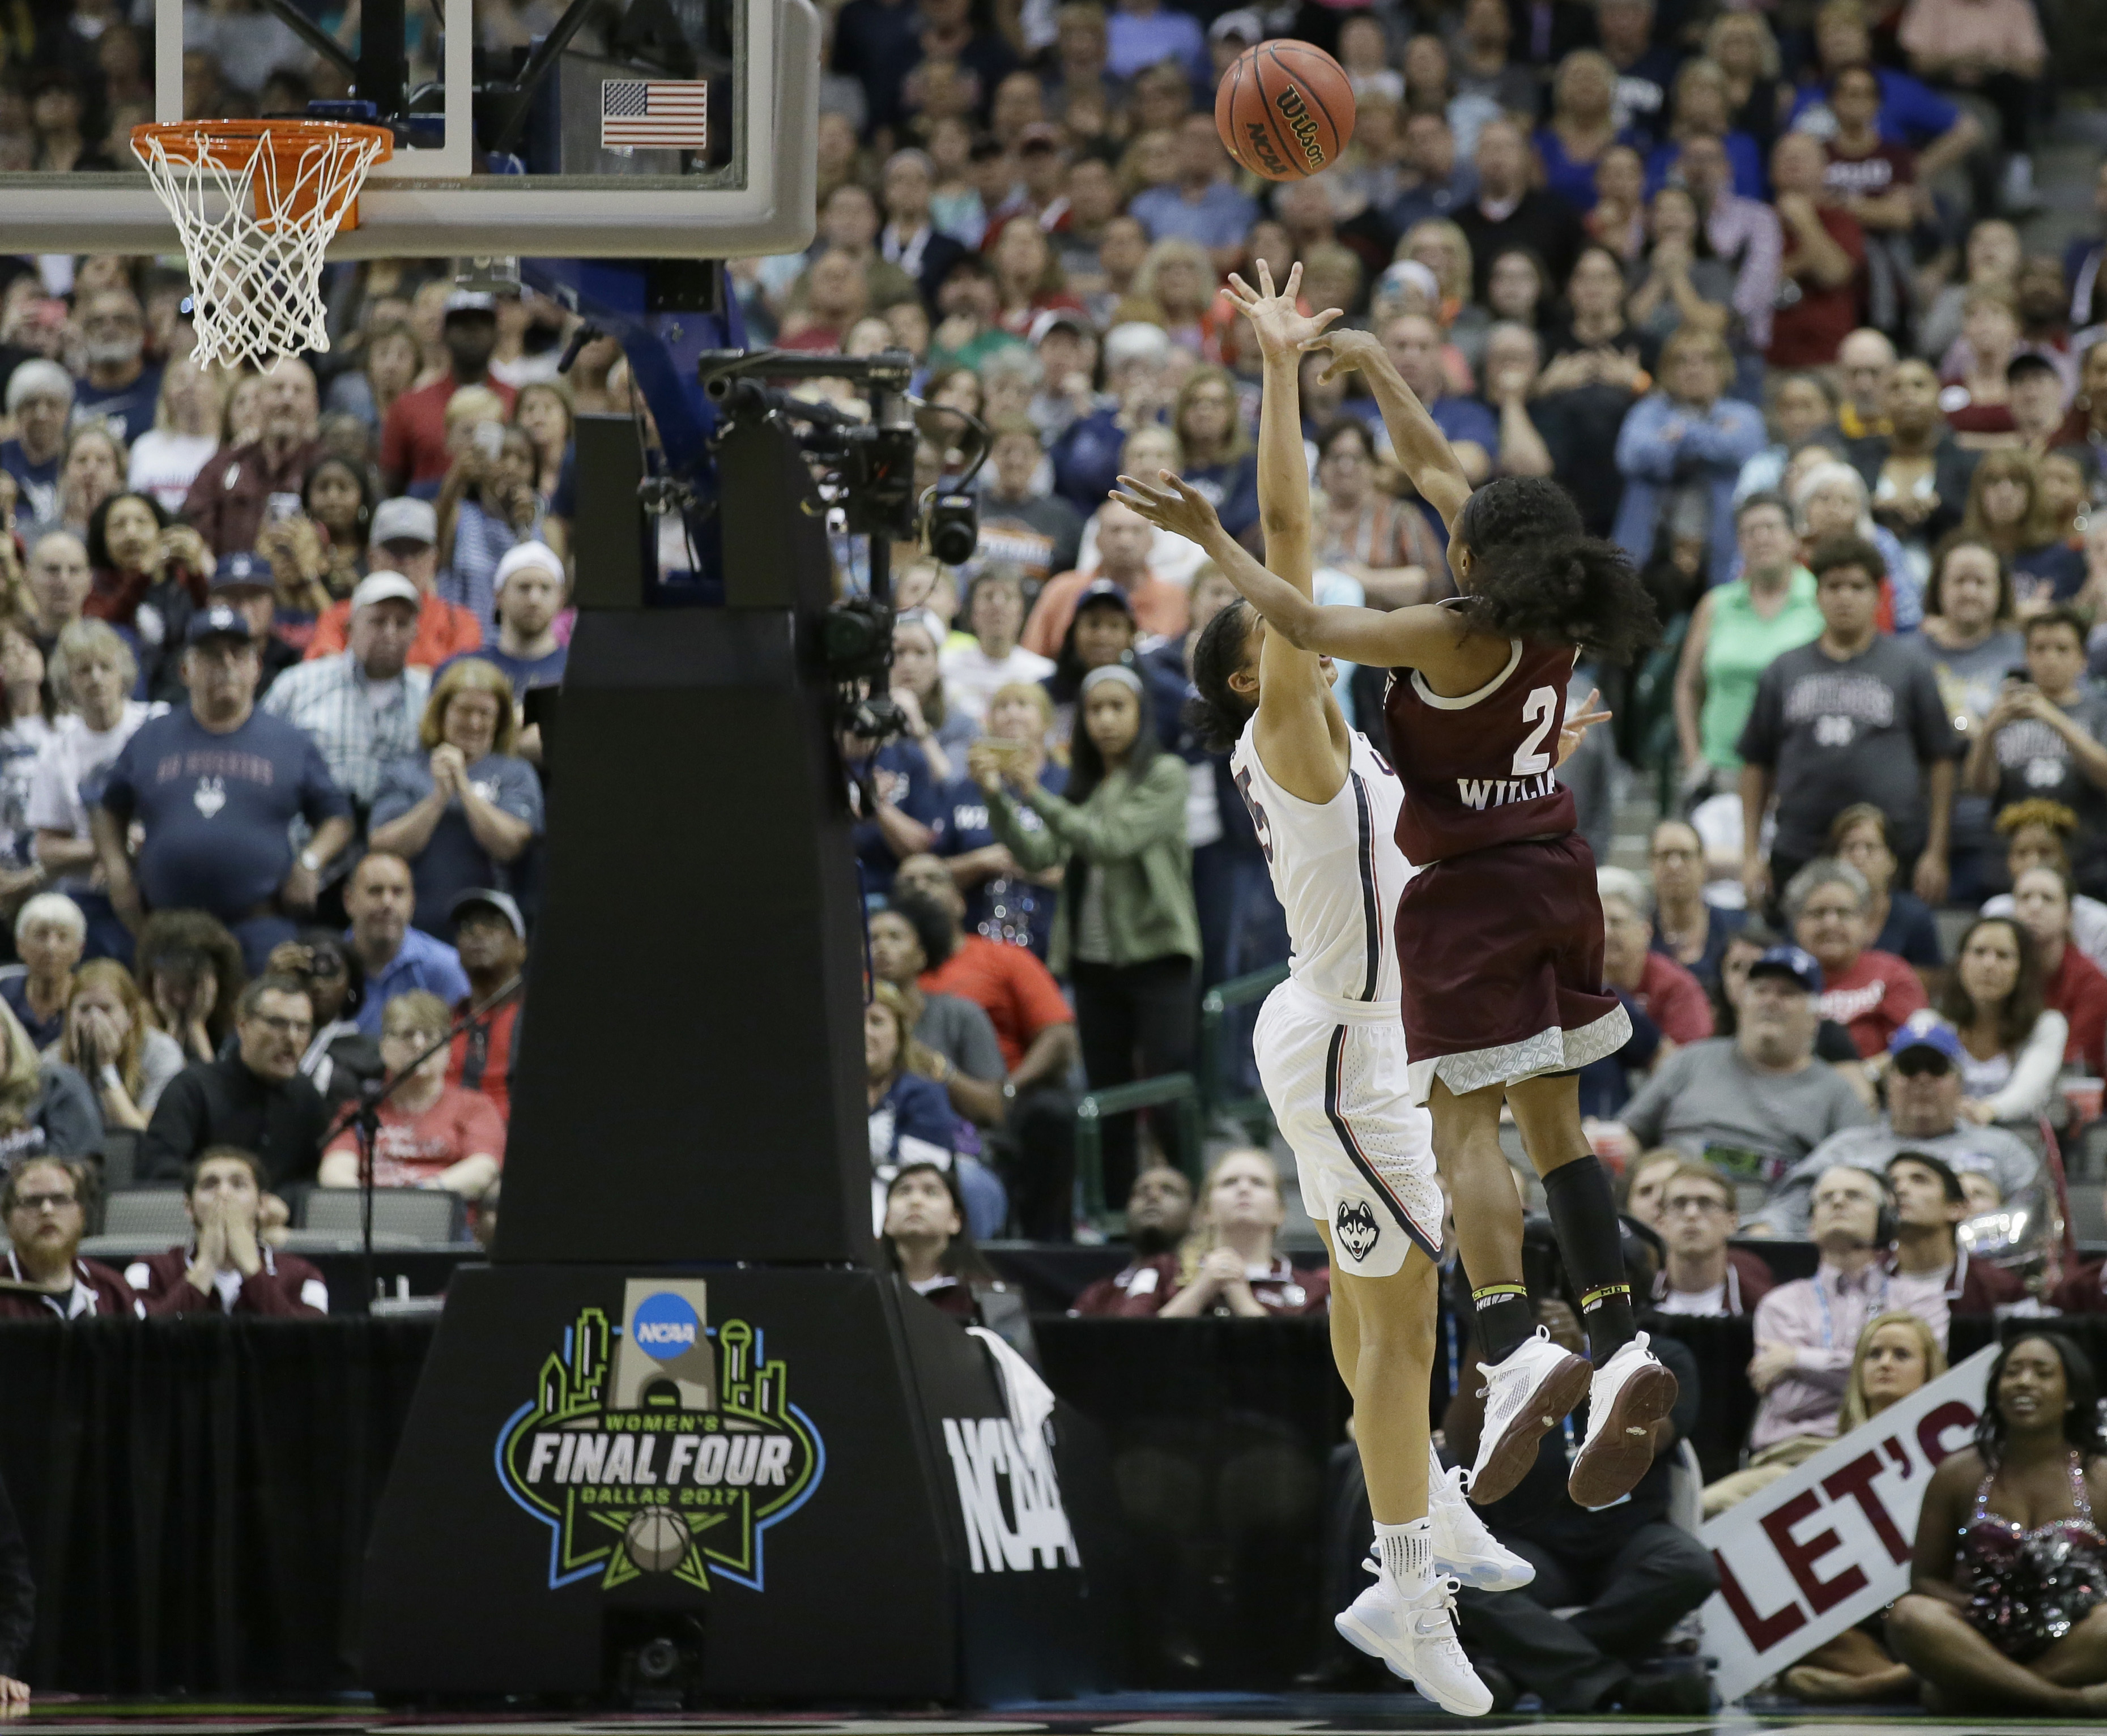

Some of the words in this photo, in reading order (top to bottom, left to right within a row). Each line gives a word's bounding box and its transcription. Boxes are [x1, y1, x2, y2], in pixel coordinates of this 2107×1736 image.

[1246, 122, 1289, 174] NCAA
[1276, 83, 1326, 169] Wilson
[1511, 685, 1558, 776] 2
[637, 1321, 695, 1343] NCAA
[605, 1414, 720, 1432] WOMEN'S
[526, 1432, 657, 1485] FINAL
[665, 1434, 793, 1486] FOUR
[580, 1486, 671, 1505] DALLAS
[680, 1487, 739, 1505] 2017
